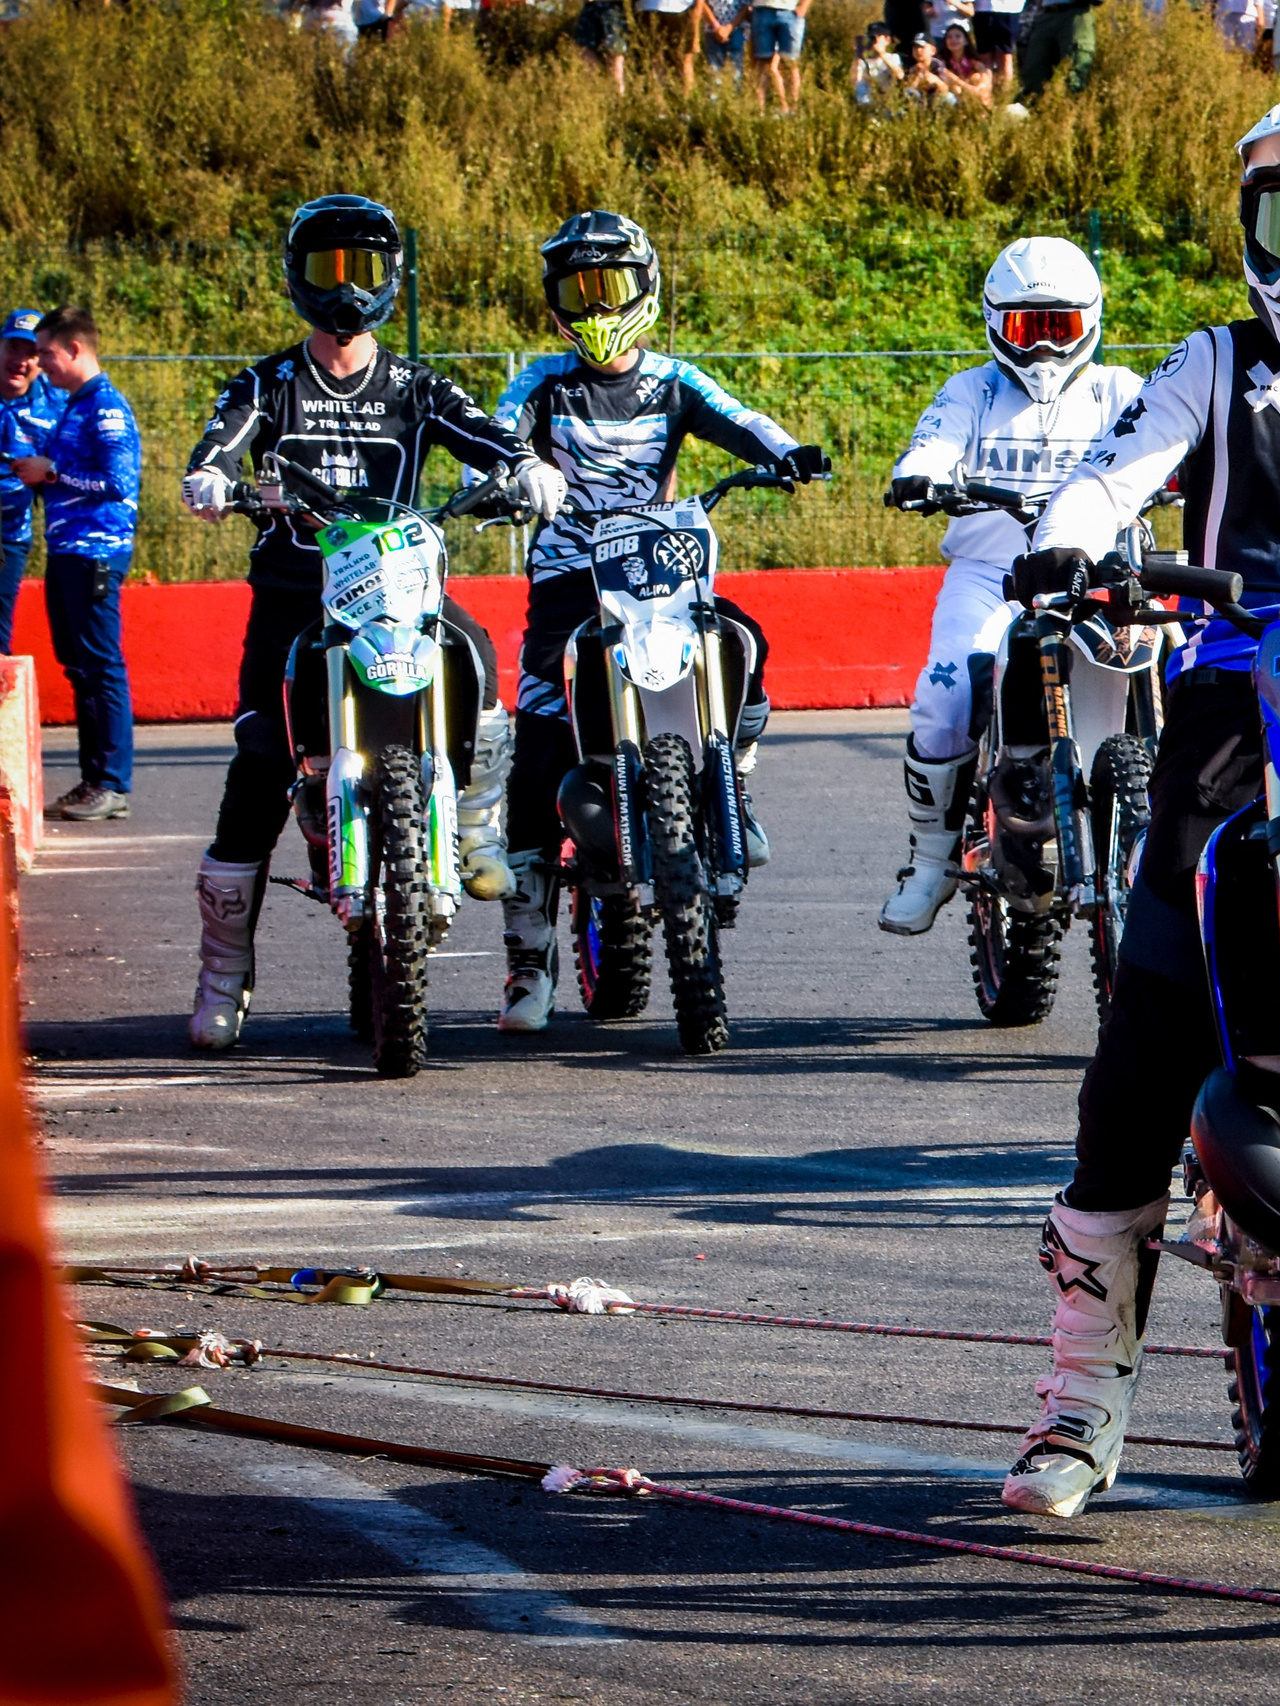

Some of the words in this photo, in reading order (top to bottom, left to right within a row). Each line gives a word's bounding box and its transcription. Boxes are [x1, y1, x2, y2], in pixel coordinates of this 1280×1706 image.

[302, 400, 386, 415] WHITELAB
[319, 419, 381, 431] TRAILHEAD
[371, 522, 427, 557] 102
[595, 535, 640, 563] 808
[638, 584, 671, 597] ALIPA
[366, 661, 427, 681] GORILLA
[616, 754, 632, 866] WWW.FMX13.COM
